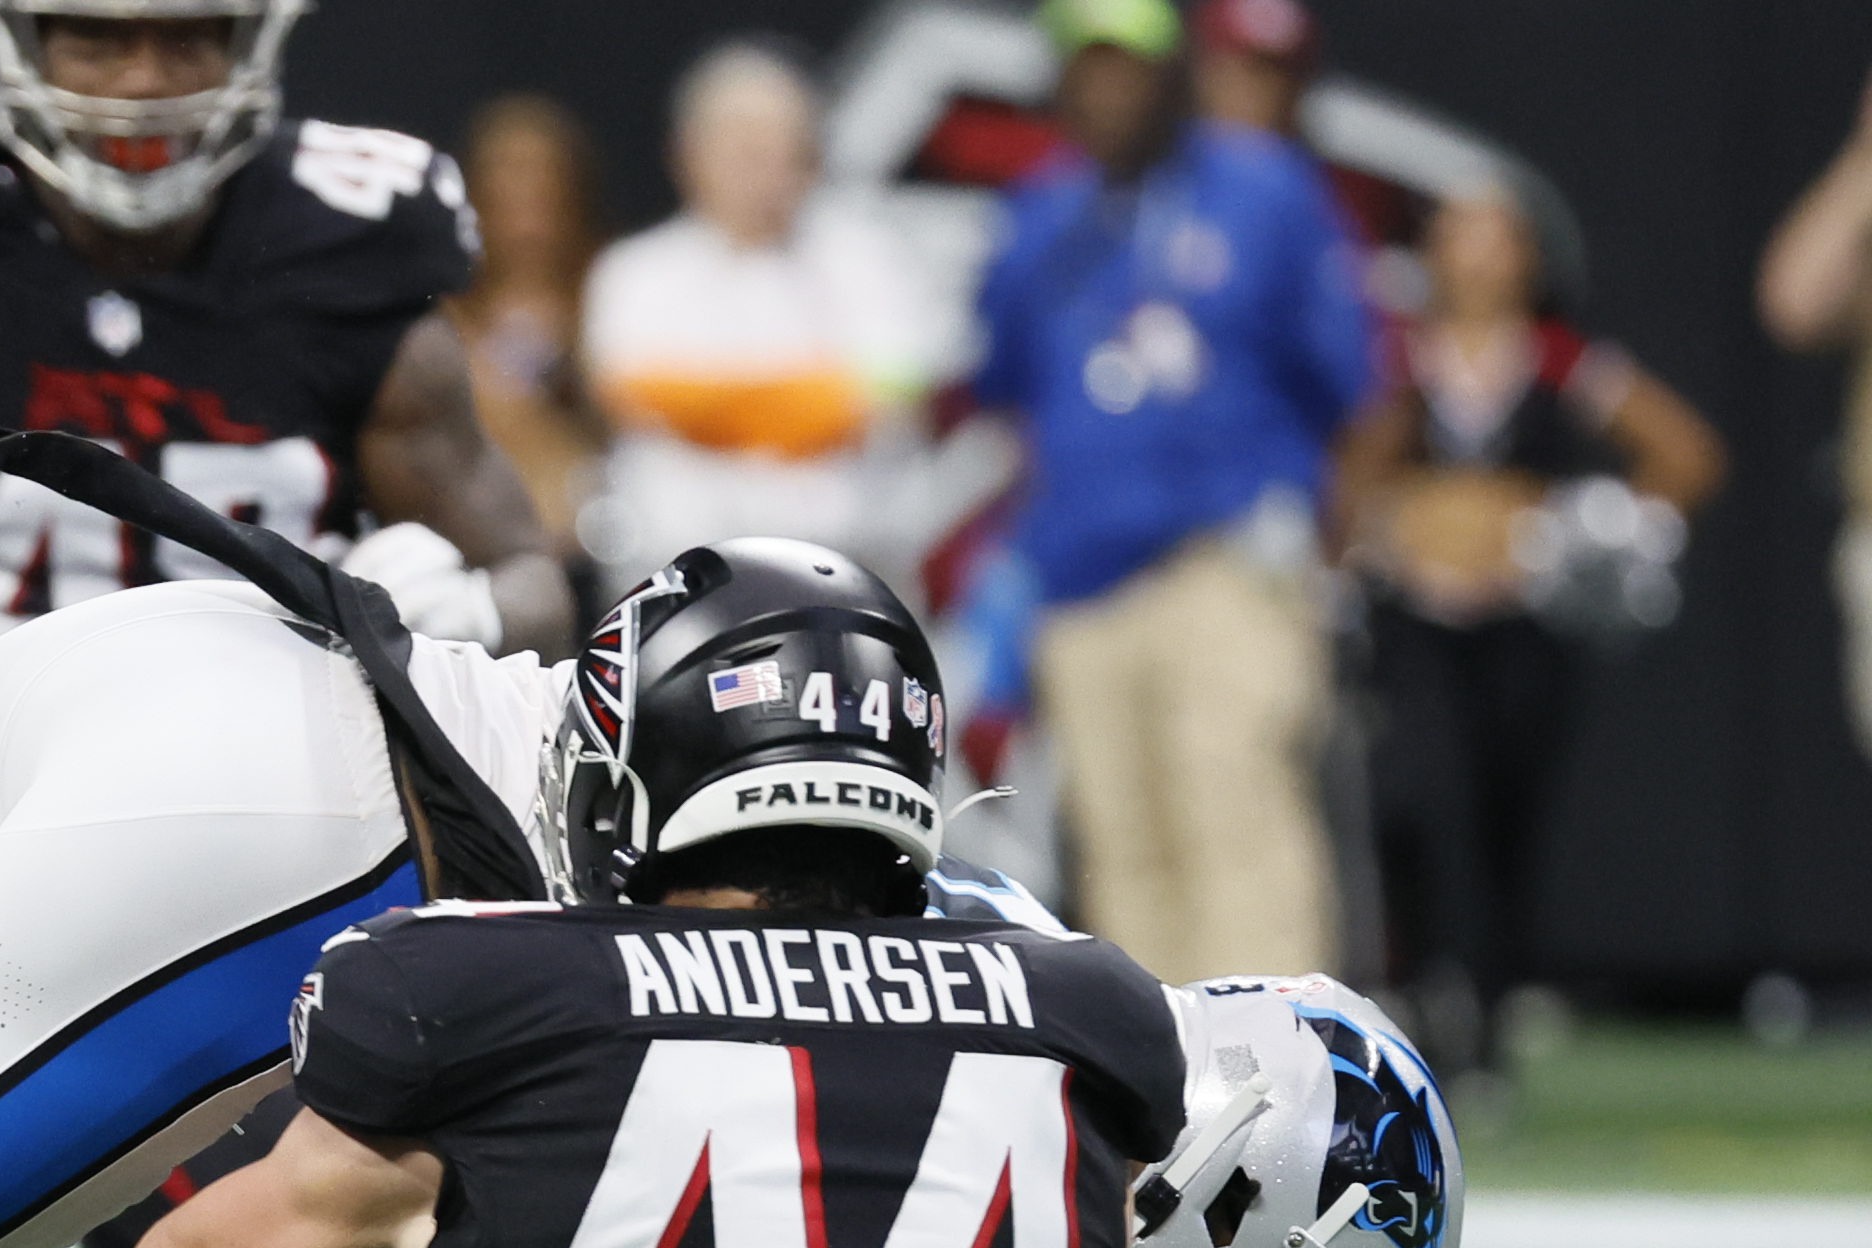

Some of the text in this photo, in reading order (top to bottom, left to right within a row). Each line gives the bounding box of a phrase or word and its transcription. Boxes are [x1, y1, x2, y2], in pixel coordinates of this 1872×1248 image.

[799, 672, 891, 741] 44
[735, 781, 934, 830] FALCONS
[615, 928, 1035, 1029] ANDERSEN
